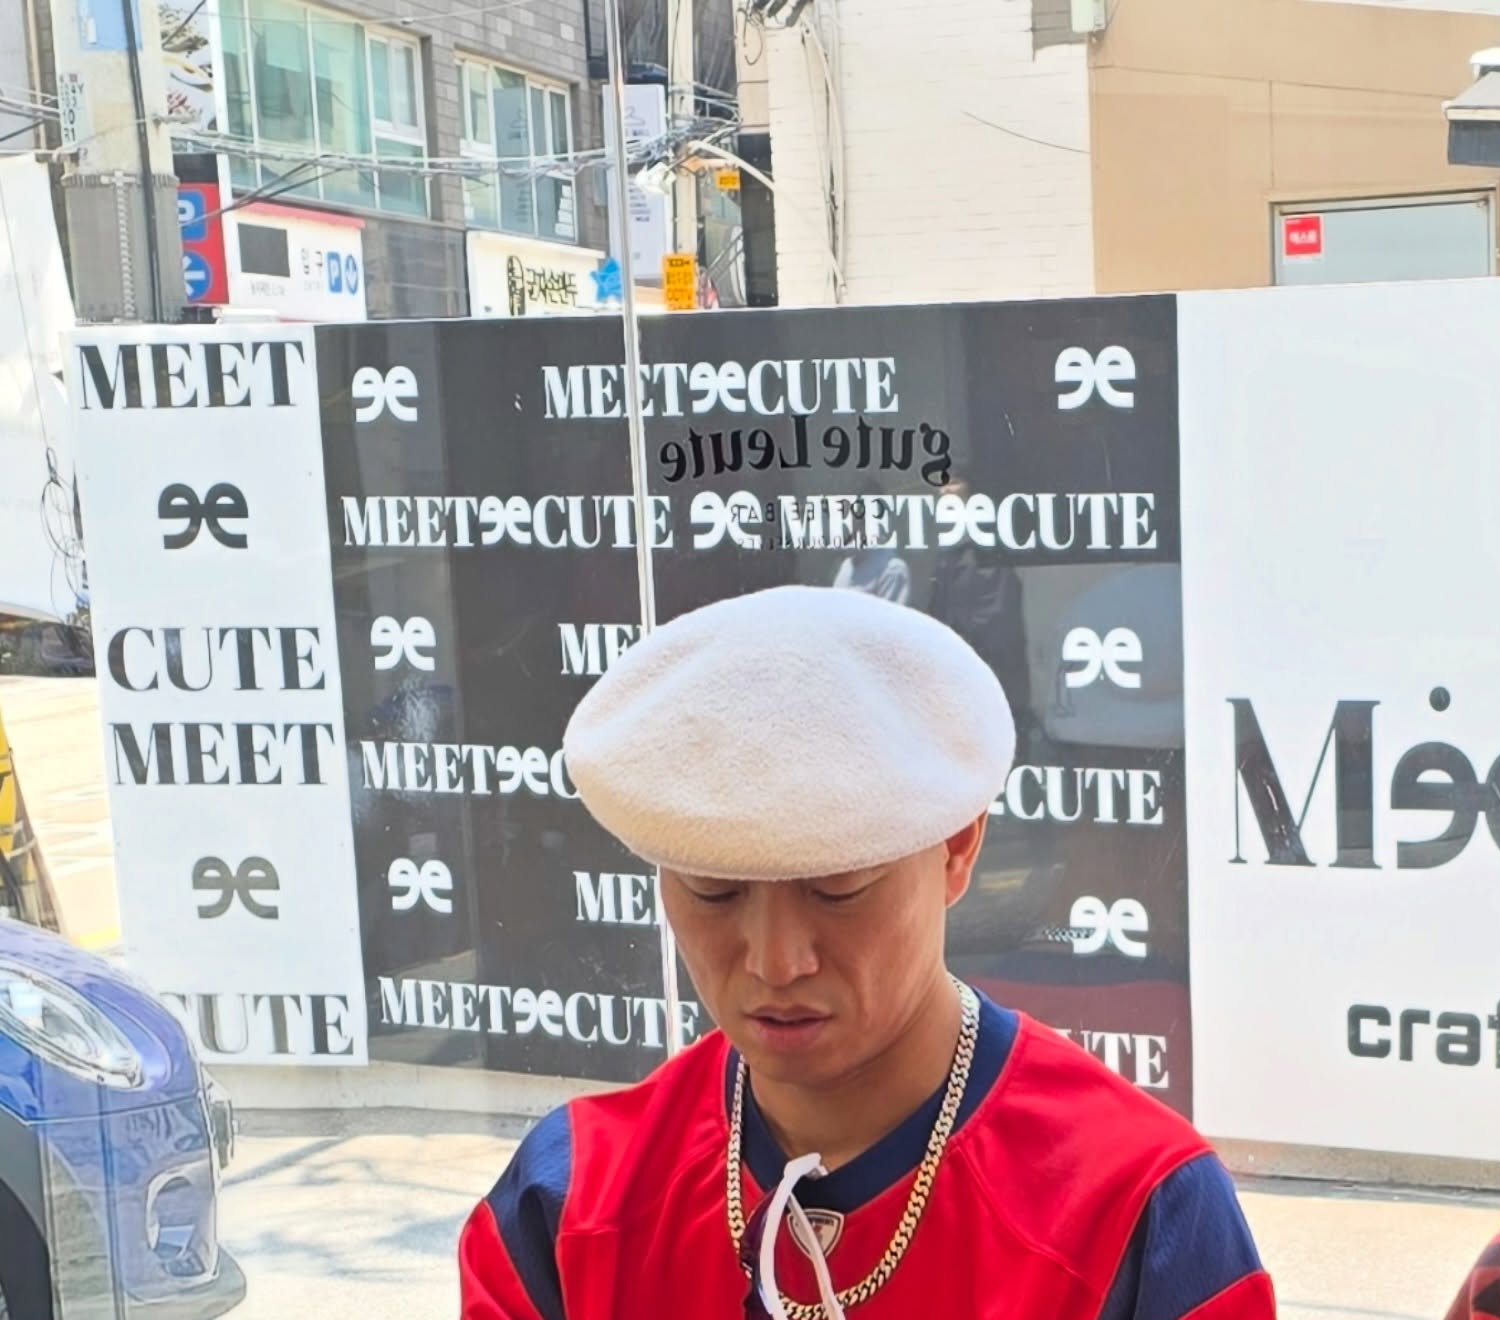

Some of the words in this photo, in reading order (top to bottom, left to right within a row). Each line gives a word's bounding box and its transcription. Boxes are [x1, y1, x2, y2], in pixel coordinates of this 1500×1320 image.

[79, 342, 305, 409] MEET
[107, 626, 326, 693] CUTE
[112, 722, 335, 786] MEET
